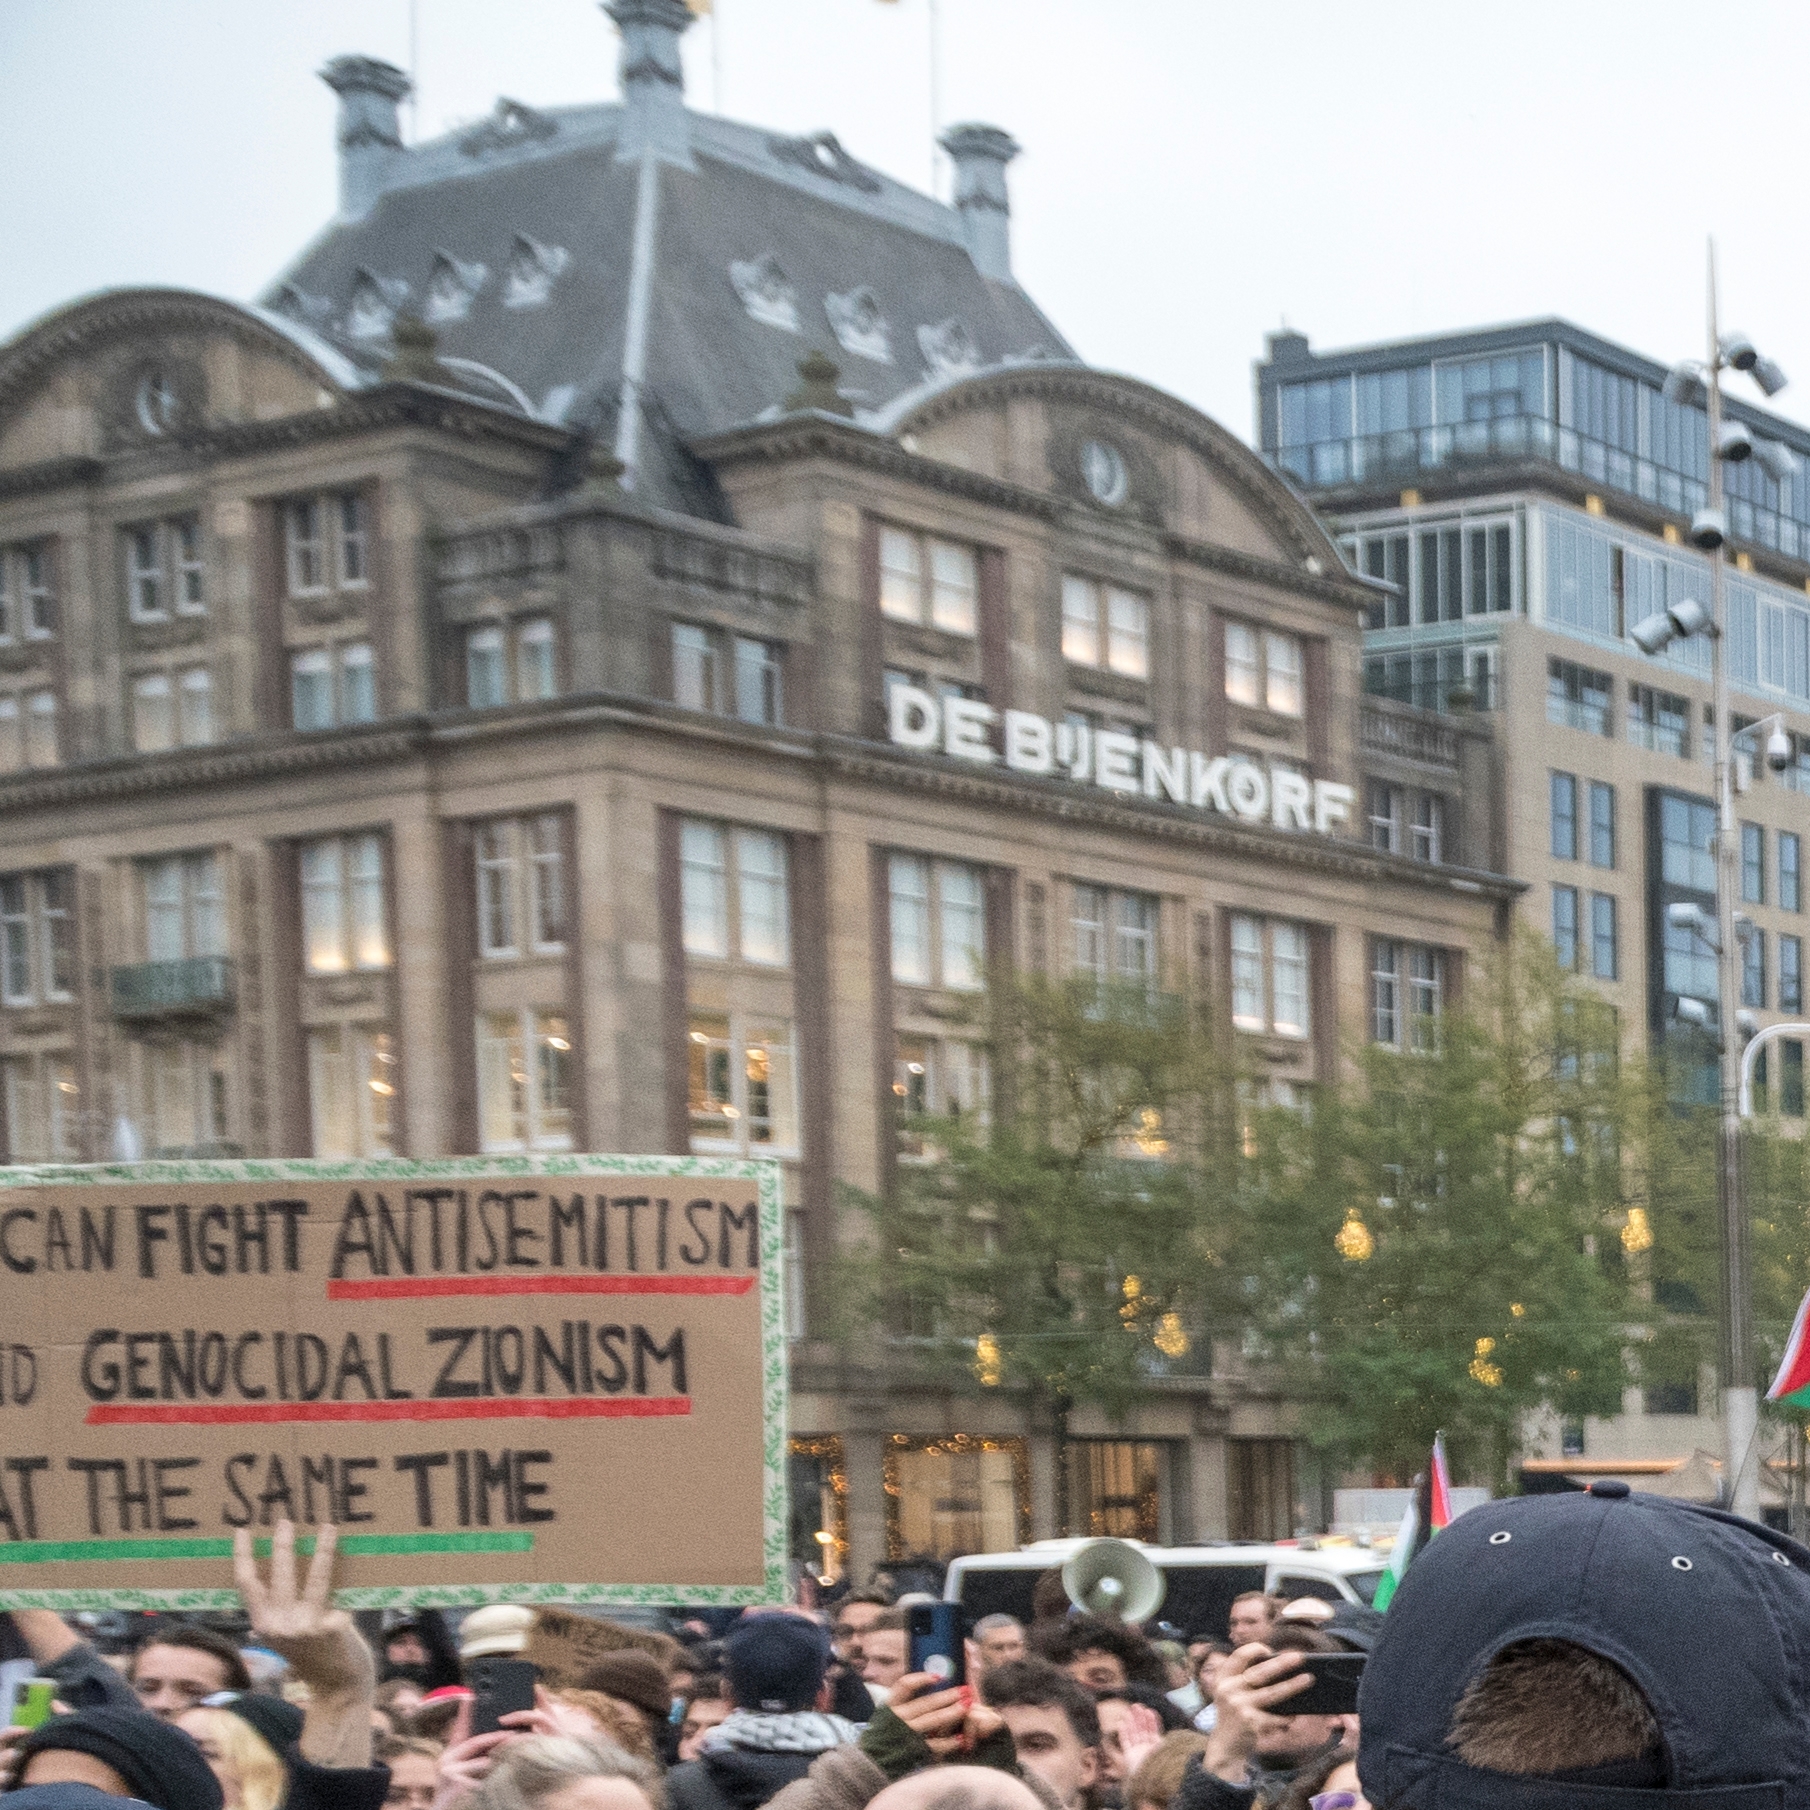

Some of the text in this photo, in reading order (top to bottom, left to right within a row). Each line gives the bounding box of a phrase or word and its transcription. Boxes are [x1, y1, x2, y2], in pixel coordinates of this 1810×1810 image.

[887, 682, 1360, 834] DE BIJENKORF
[1, 1187, 760, 1279] CAN FIGHT ANTISEMITISM
[0, 1320, 688, 1406] D GENOCIDAL ZIONISM
[66, 1456, 201, 1535] THE
[221, 1452, 379, 1528] SAME
[395, 1449, 556, 1528] TIME
